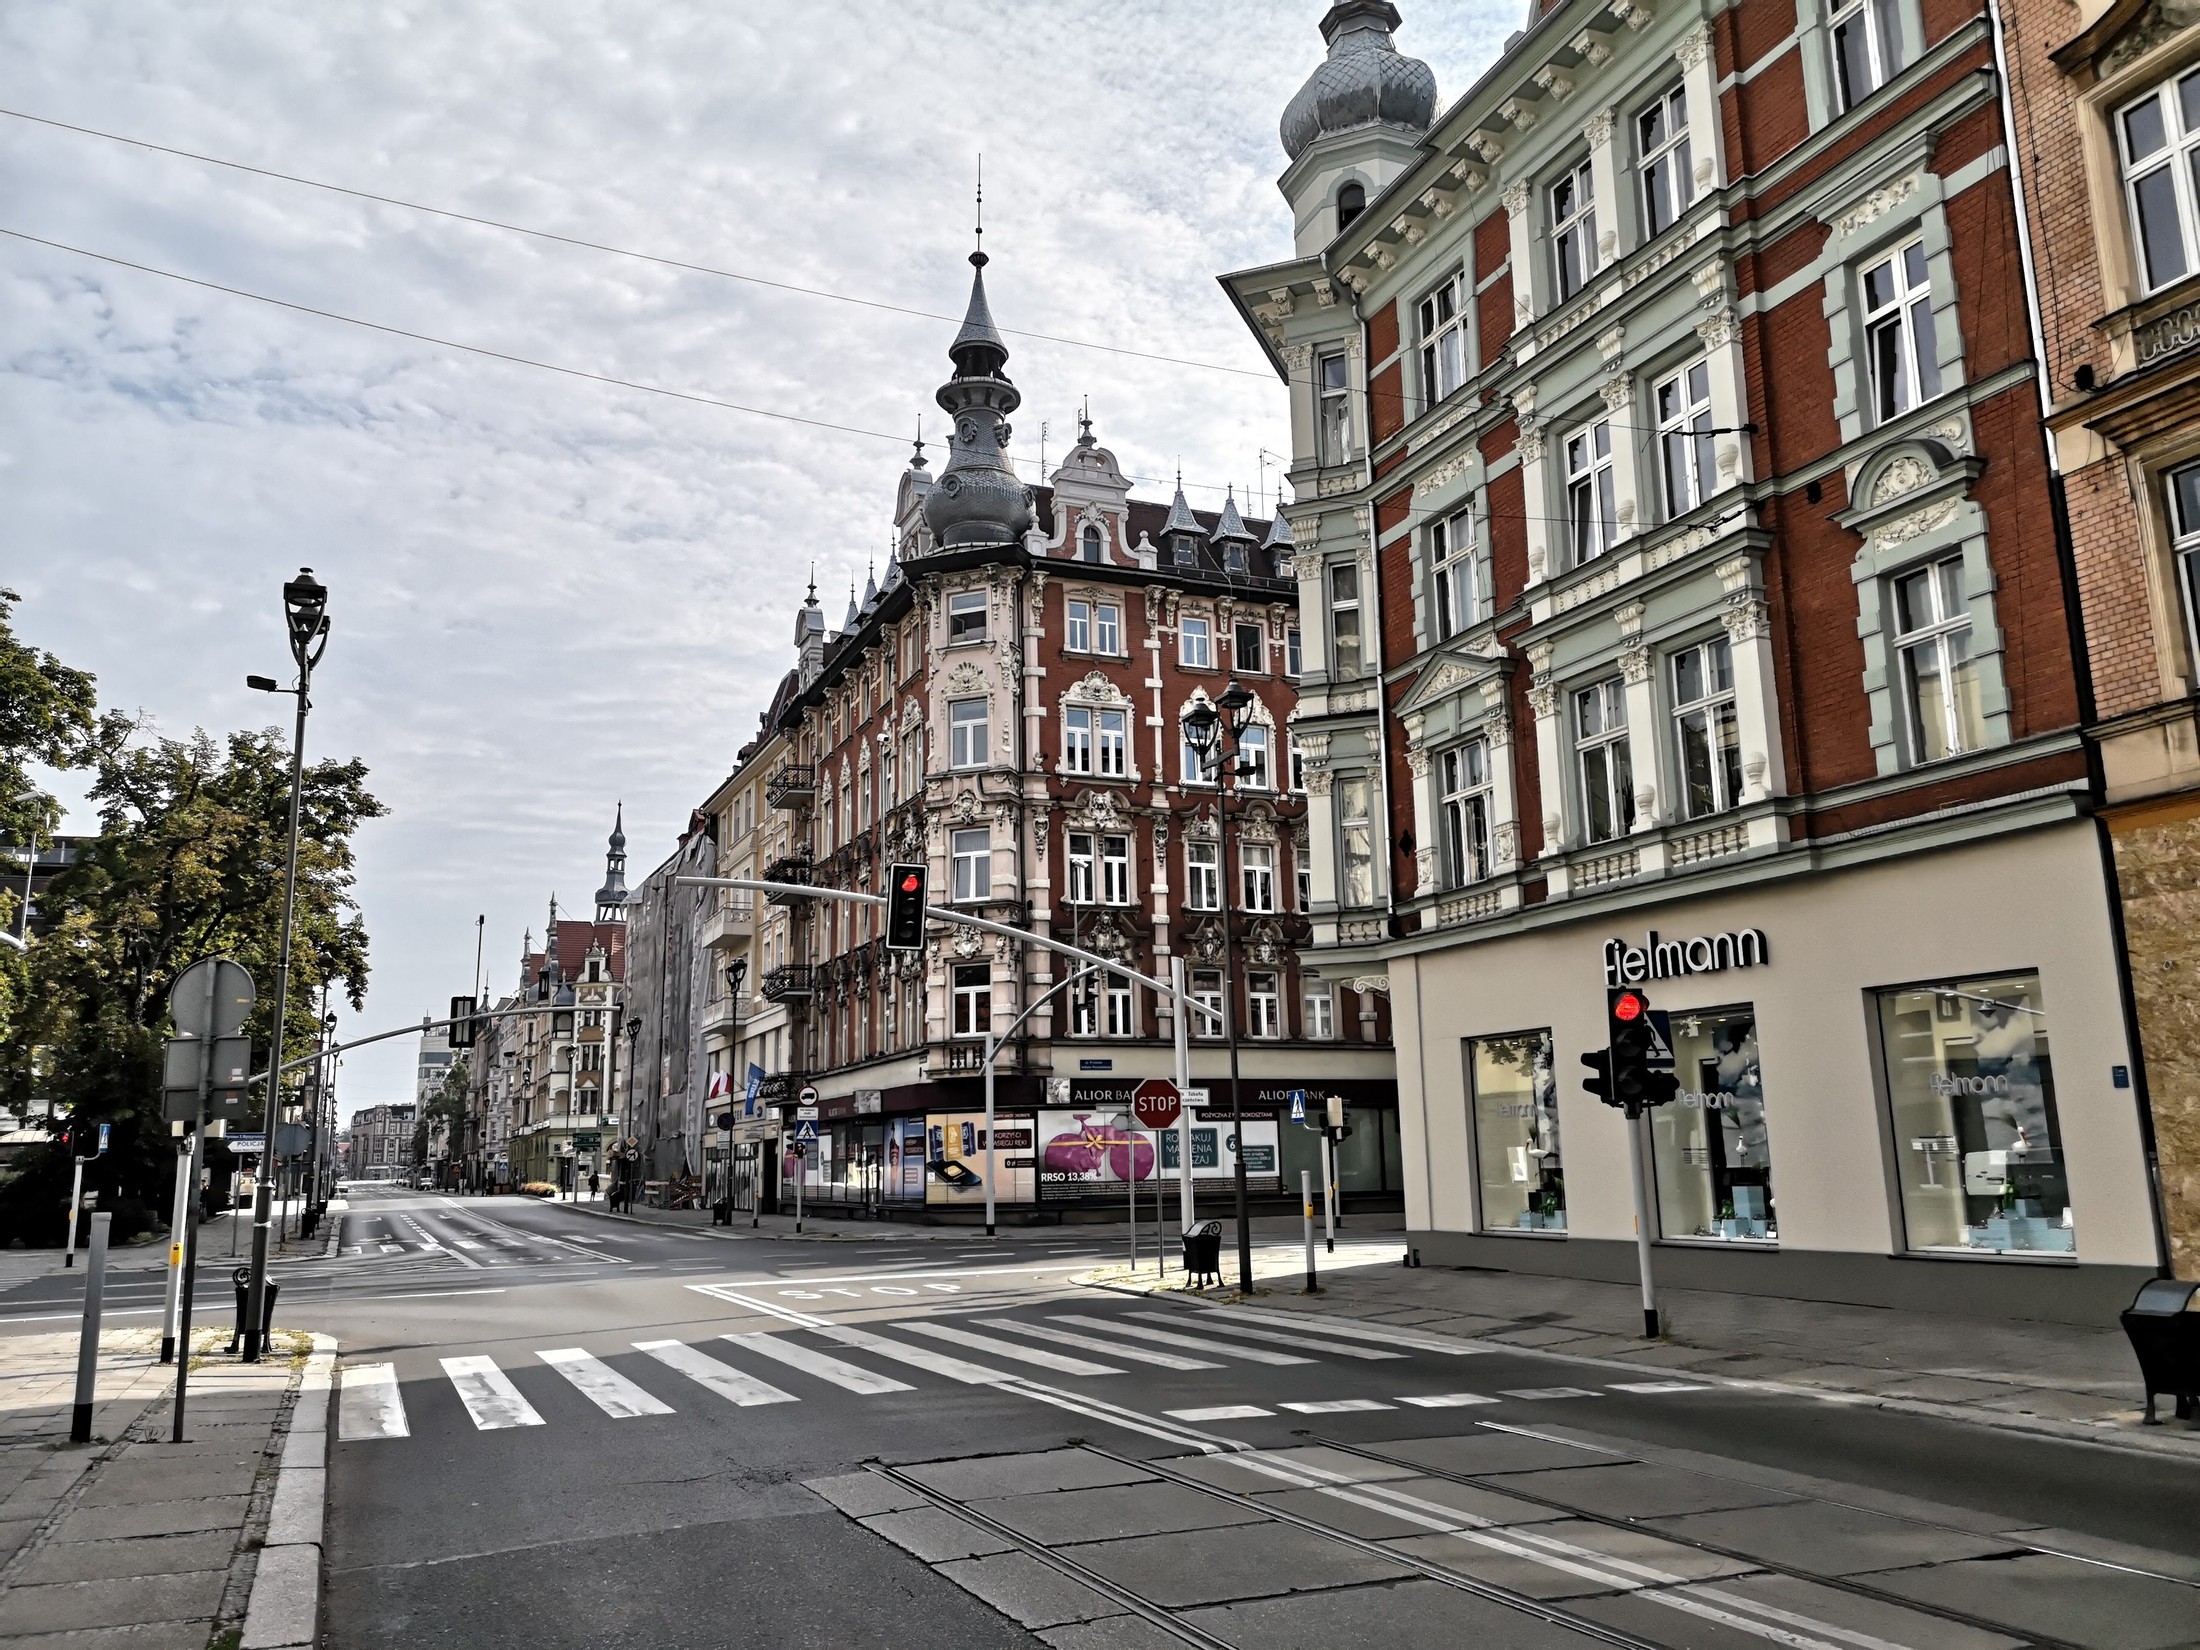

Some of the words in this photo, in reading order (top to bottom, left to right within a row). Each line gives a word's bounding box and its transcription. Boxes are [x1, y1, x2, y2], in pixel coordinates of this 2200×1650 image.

[1603, 928, 1766, 986] fielmann
[1075, 1090, 1112, 1101] ALIOR
[1116, 1090, 1134, 1100] BA
[1304, 1090, 1325, 1100] ANK
[1139, 1096, 1177, 1112] STOP
[1166, 1133, 1211, 1143] ROAKUJ
[1166, 1144, 1212, 1153] MAENIA
[1041, 1173, 1066, 1182] RRSO
[778, 1283, 963, 1300] STOP
